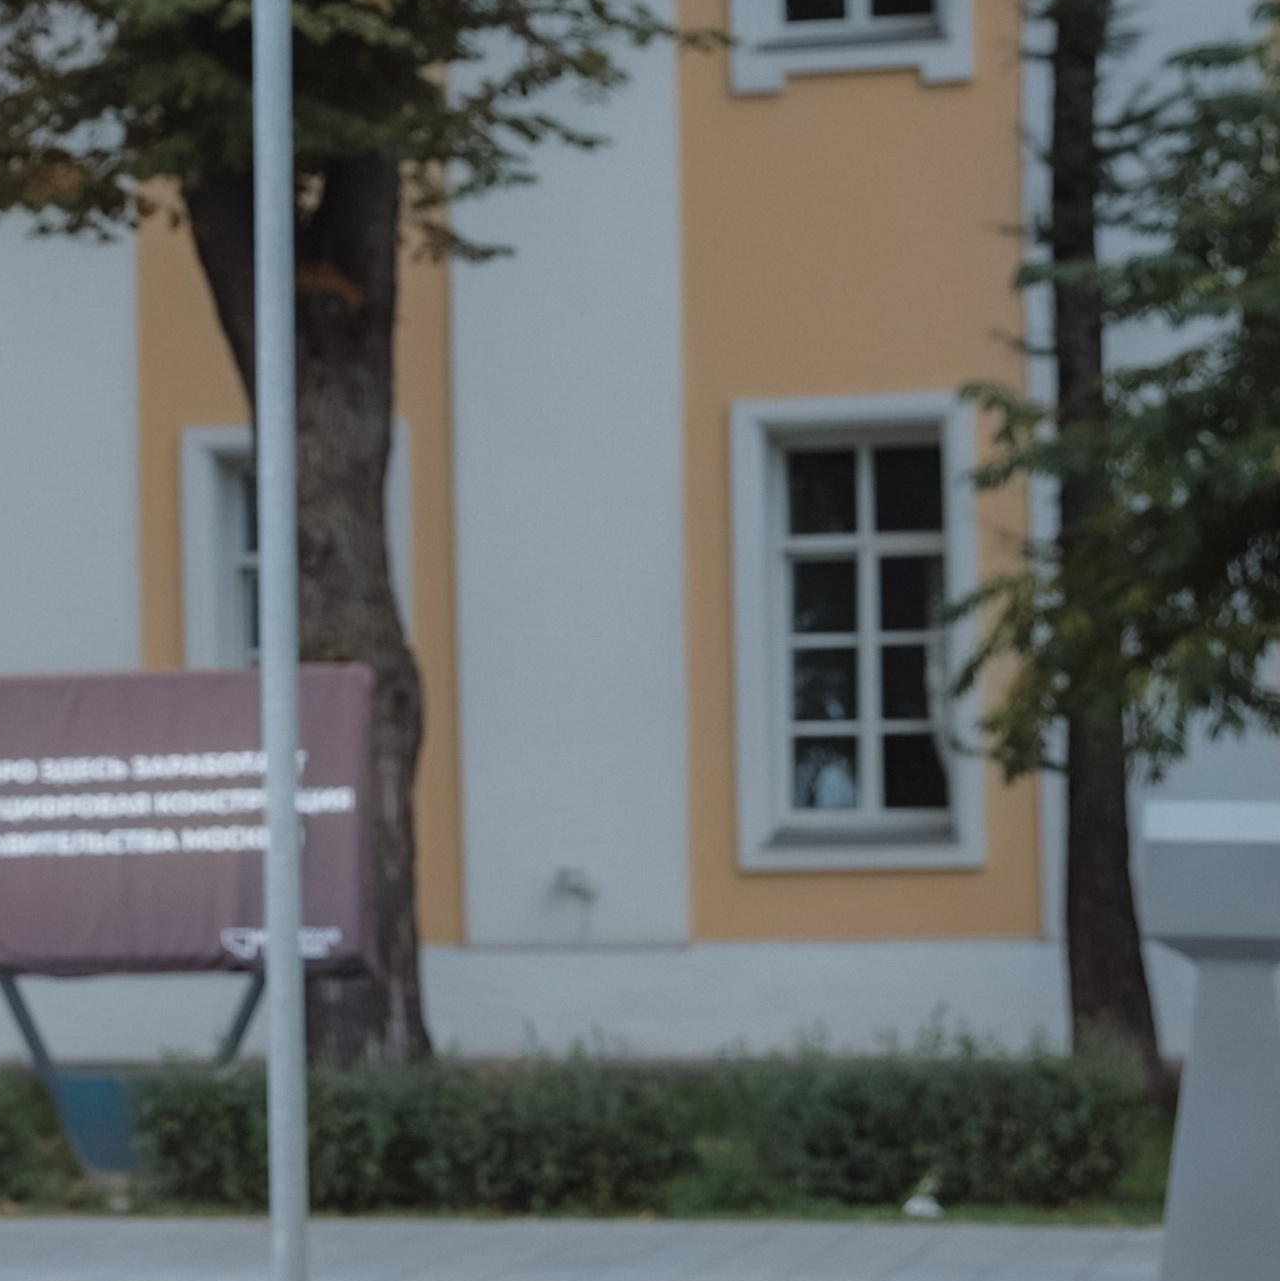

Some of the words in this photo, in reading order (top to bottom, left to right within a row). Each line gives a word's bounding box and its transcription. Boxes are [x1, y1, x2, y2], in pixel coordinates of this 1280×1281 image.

[40, 756, 129, 783] ЗДЕСЬ
[130, 750, 306, 781] ЗАРАБОТАТ
[154, 787, 354, 815] КОНСТРЦИЯ
